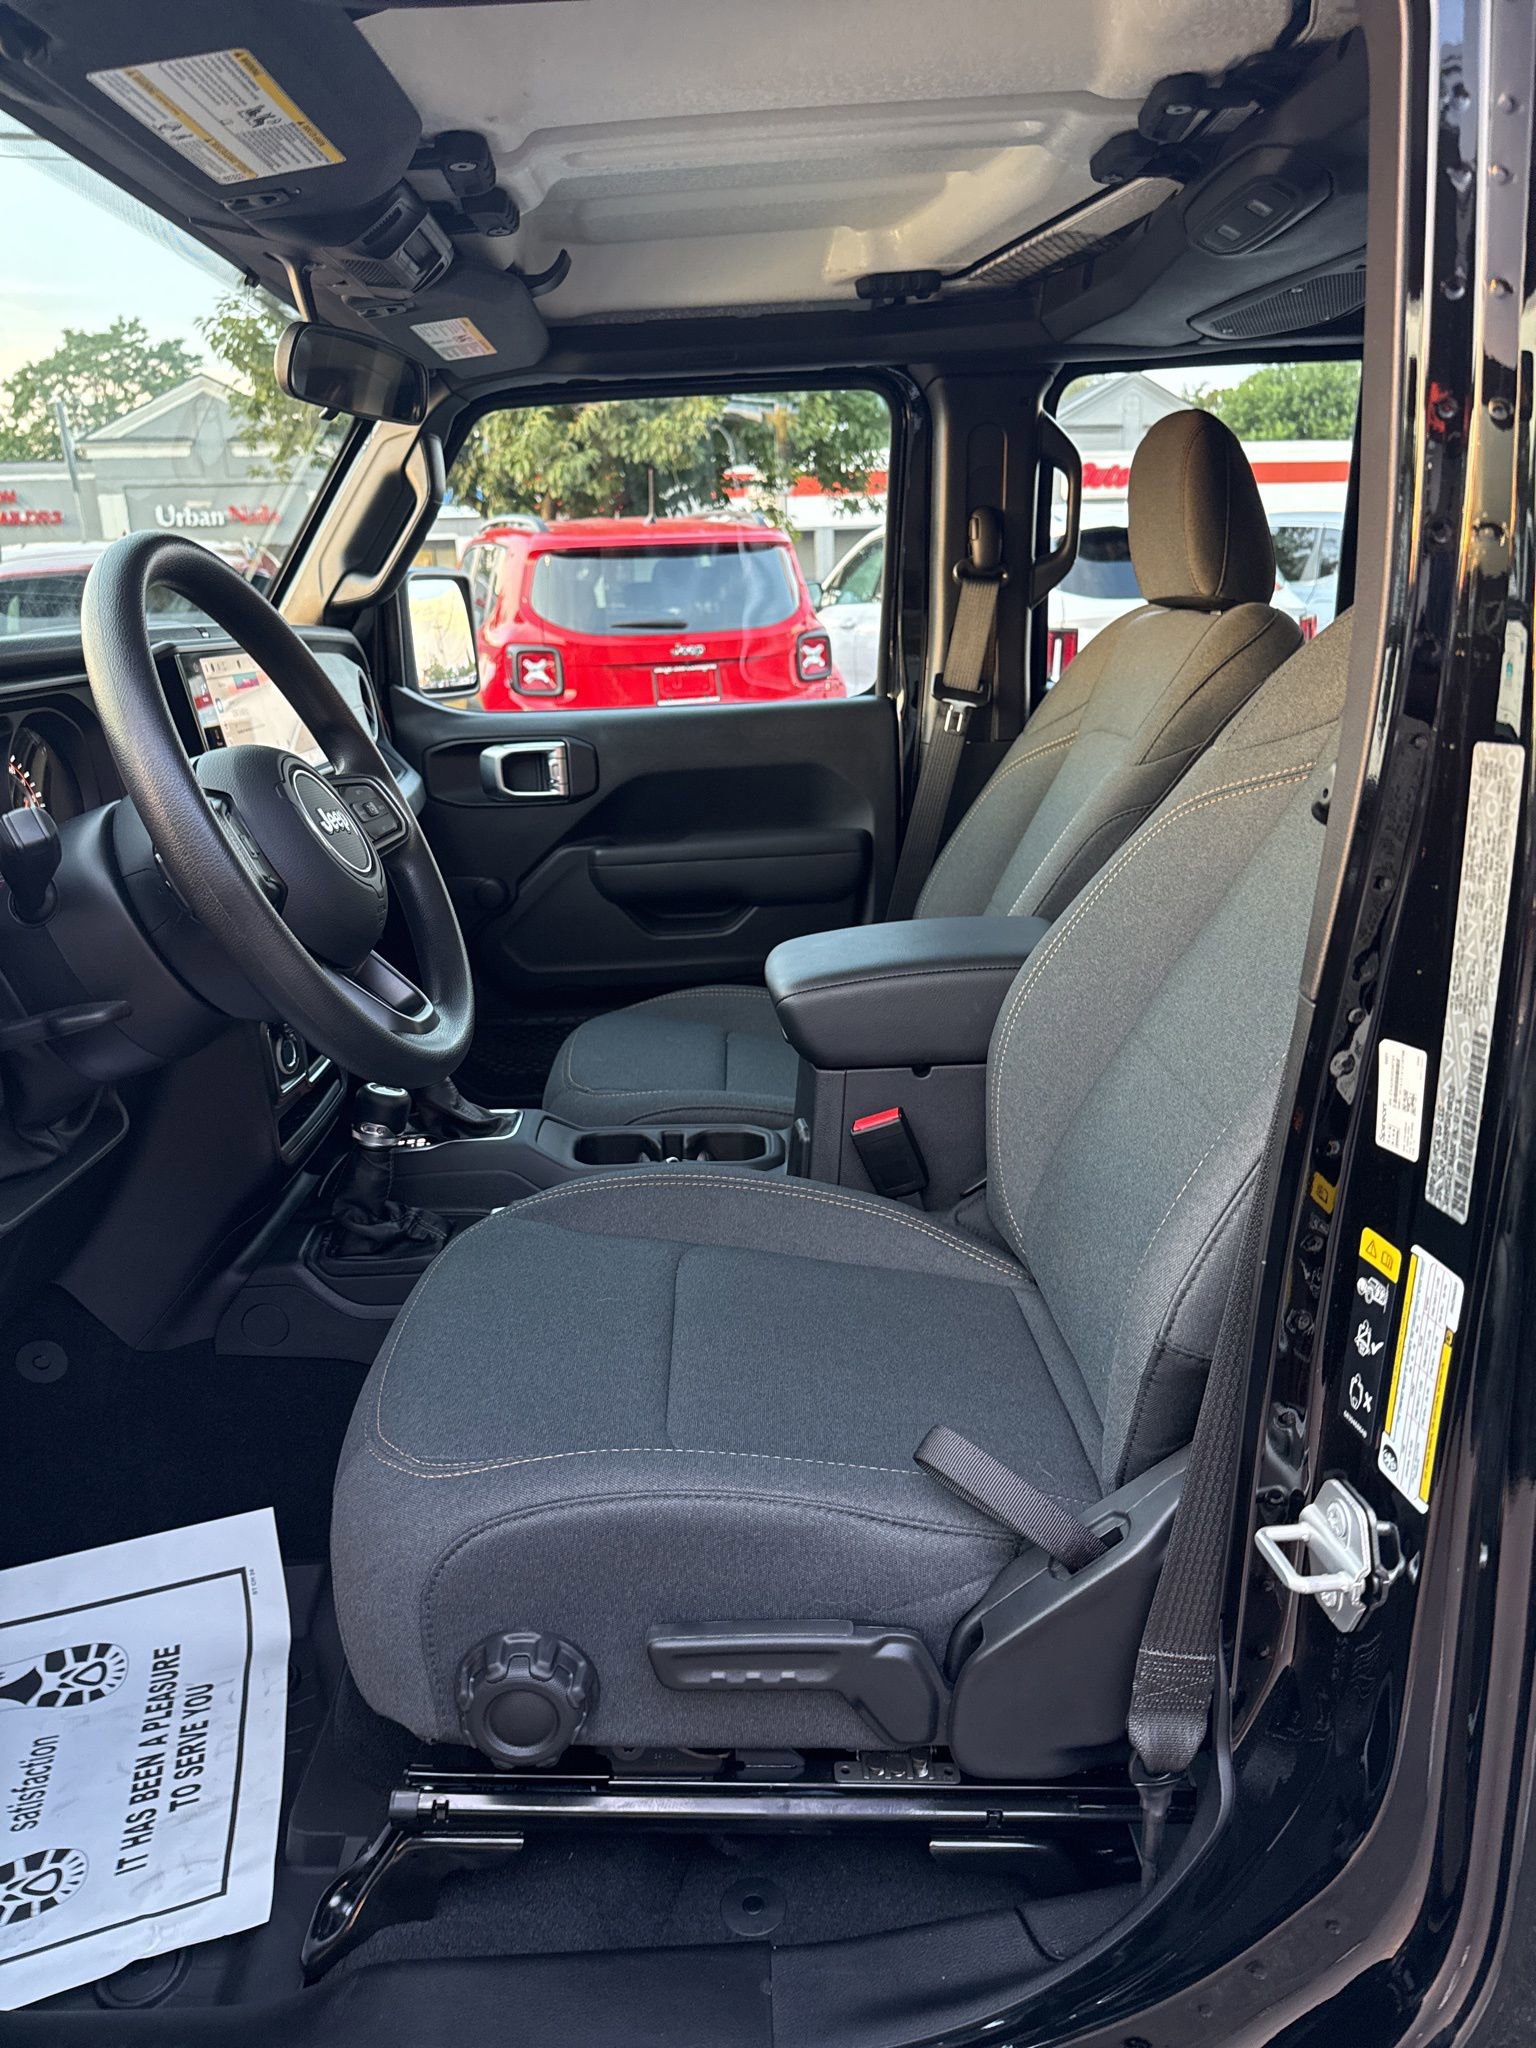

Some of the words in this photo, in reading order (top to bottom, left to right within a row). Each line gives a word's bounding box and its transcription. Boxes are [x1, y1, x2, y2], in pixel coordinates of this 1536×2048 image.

[155, 503, 225, 528] Urban
[316, 807, 351, 835] Jeep
[141, 1644, 181, 1733] PLEASURE
[182, 1683, 214, 1720] YOU
[138, 1733, 169, 1747] A
[173, 1719, 209, 1780] SERVE
[6, 1735, 59, 1832] satisfaction
[129, 1752, 166, 1805] BEEN
[168, 1783, 202, 1813] TO
[120, 1808, 157, 1851] HAS
[114, 1854, 149, 1876] IT
